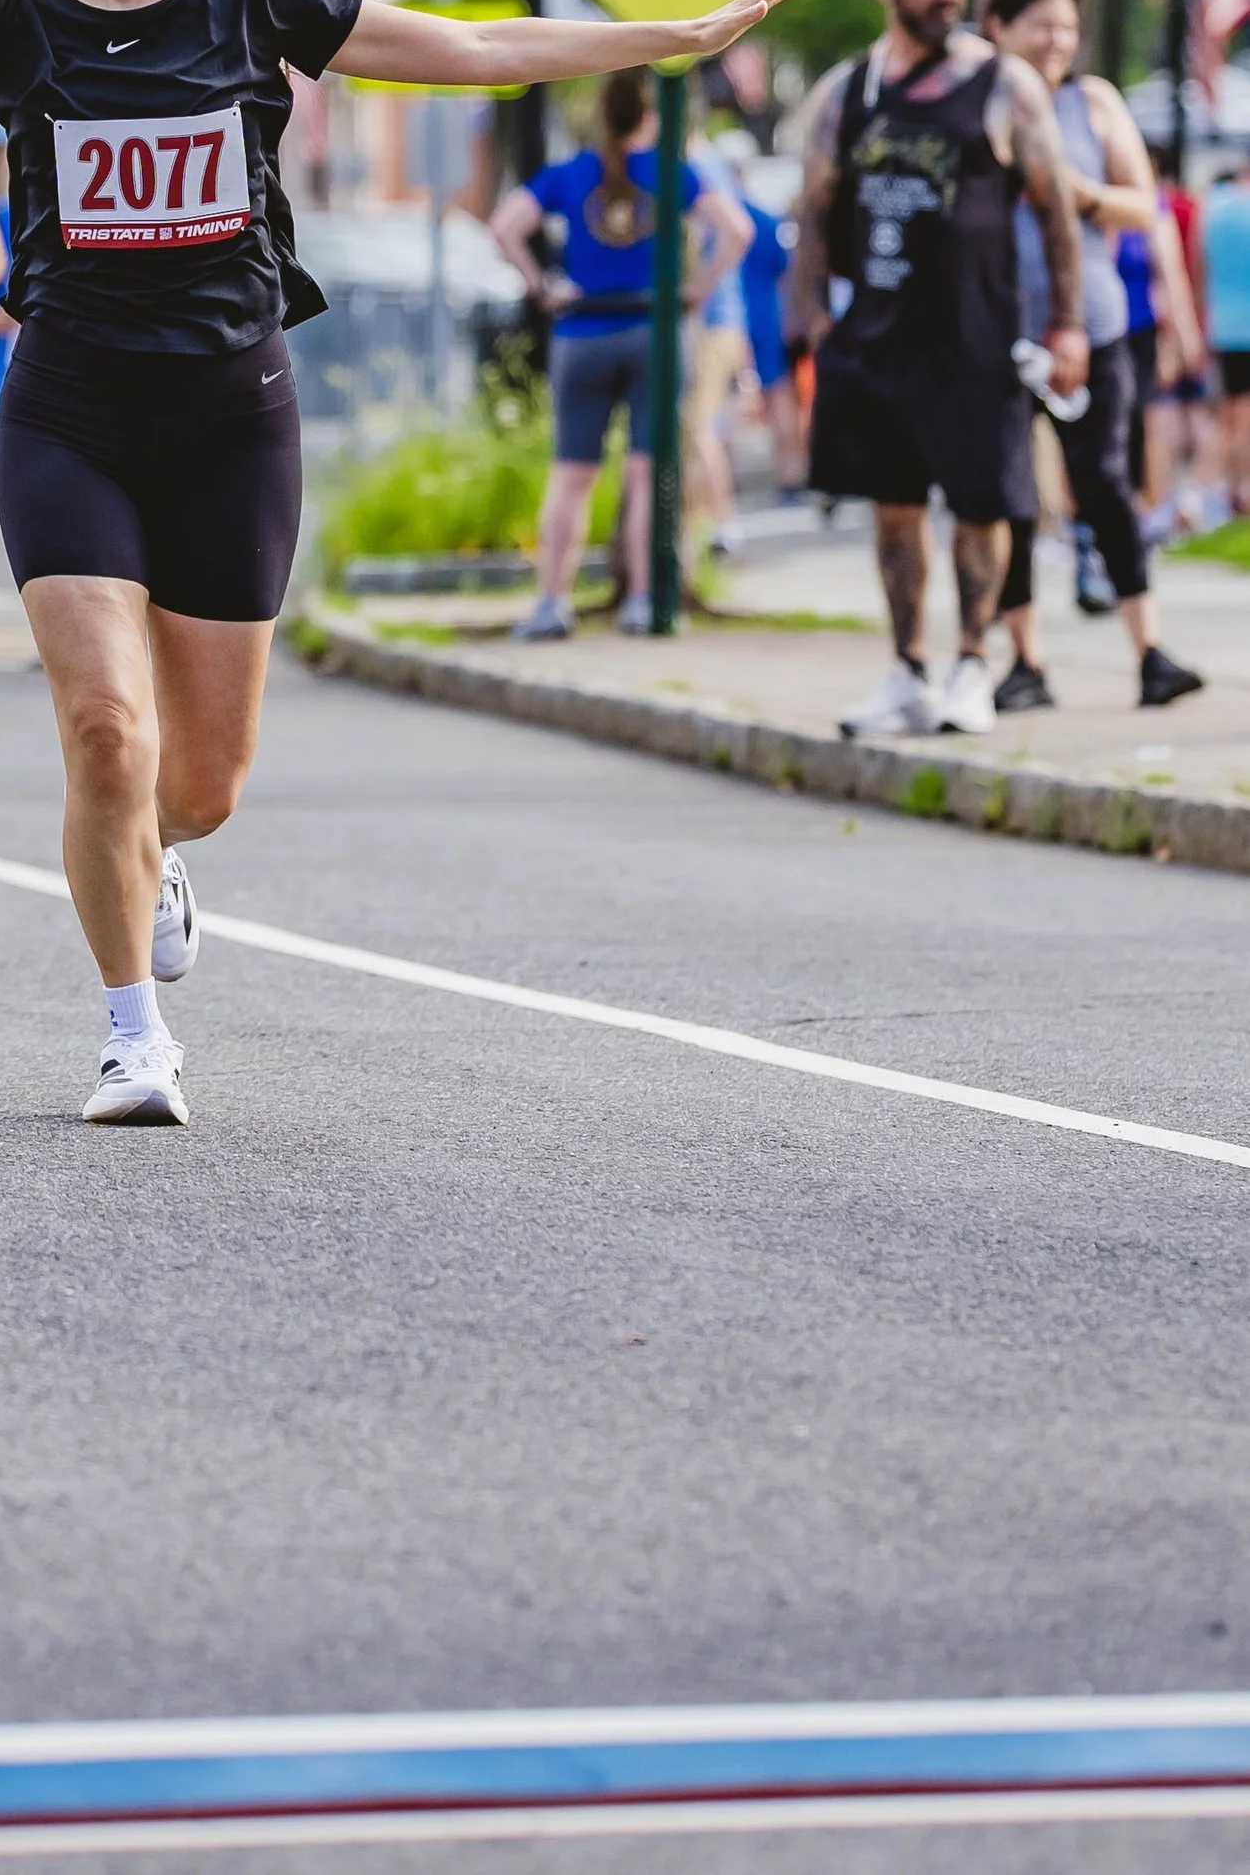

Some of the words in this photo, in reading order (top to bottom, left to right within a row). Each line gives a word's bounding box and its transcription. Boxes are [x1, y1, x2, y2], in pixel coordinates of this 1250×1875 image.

[78, 129, 225, 211] 2077
[68, 228, 155, 240] TRISTATE
[176, 217, 243, 238] TIMING
